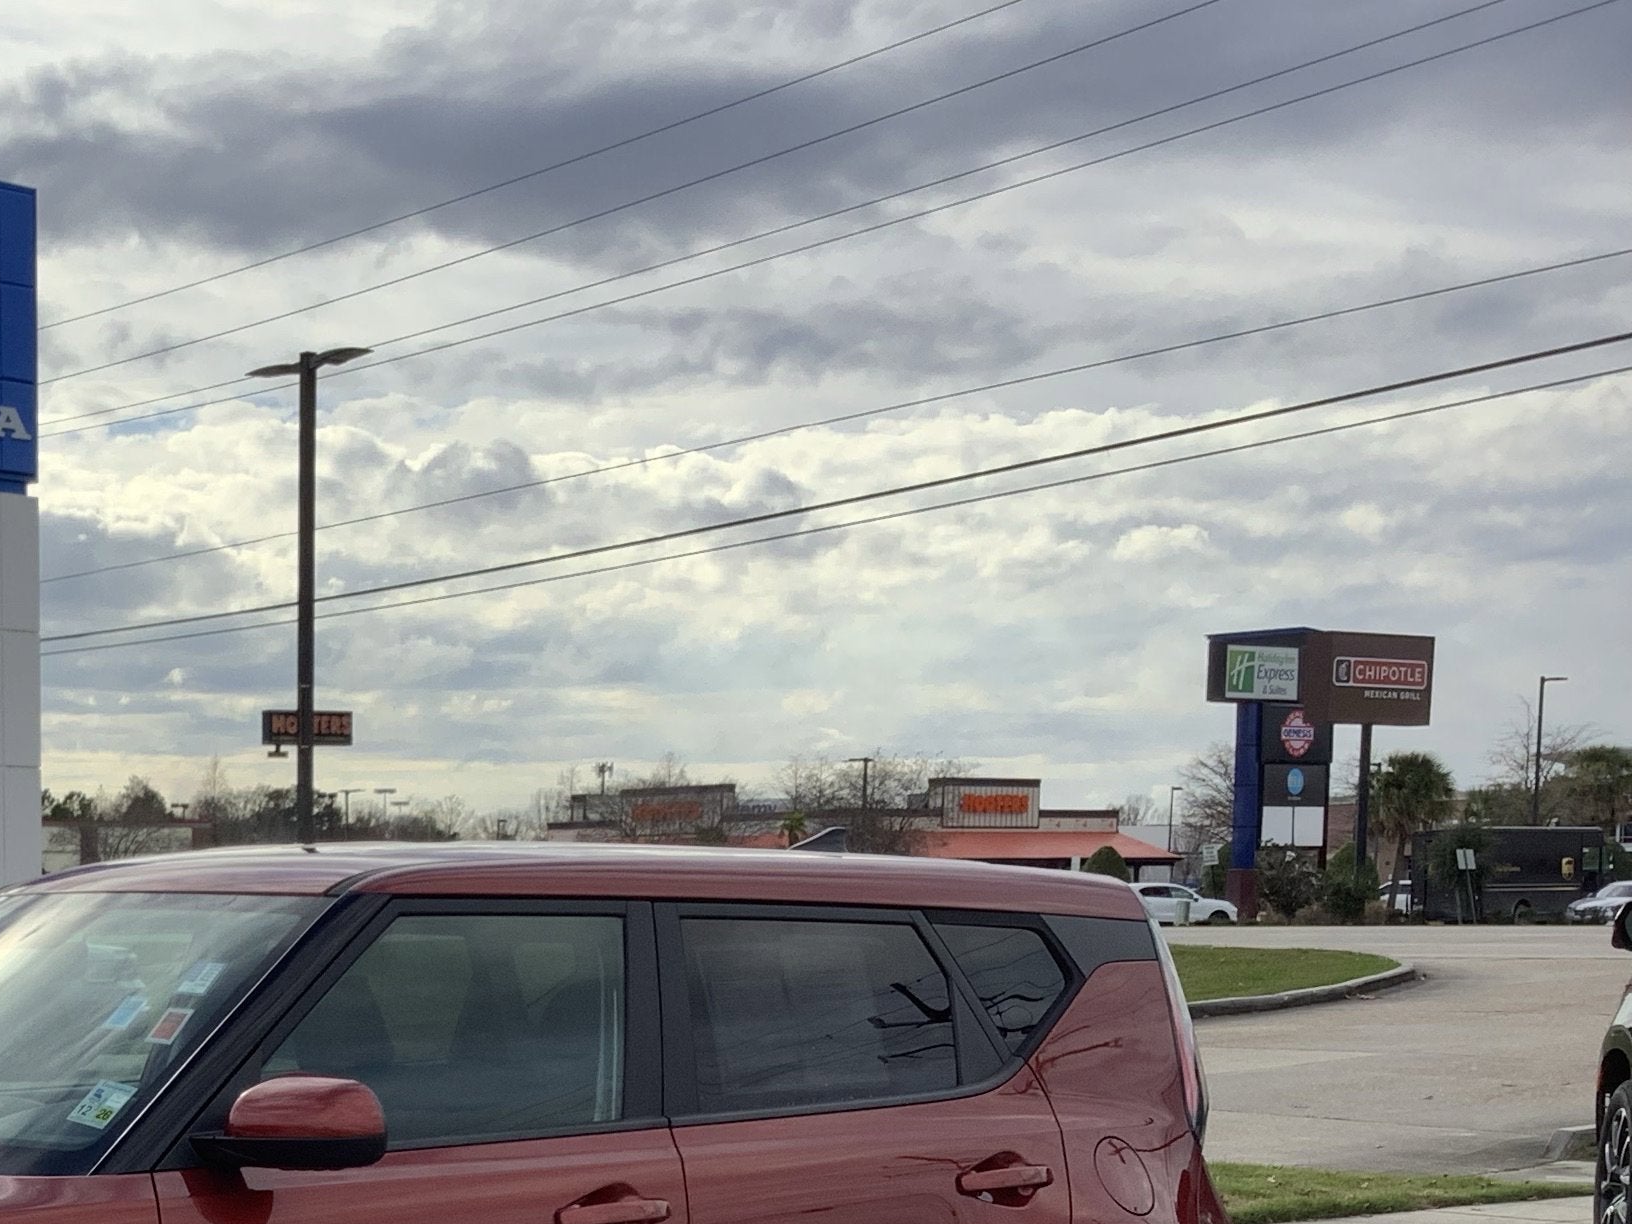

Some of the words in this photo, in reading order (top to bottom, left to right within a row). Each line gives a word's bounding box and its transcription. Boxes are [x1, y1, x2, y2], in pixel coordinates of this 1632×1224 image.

[1257, 664, 1295, 683] Express
[1355, 665, 1423, 682] CHIPOTLE
[1364, 690, 1398, 699] MEXICAN
[1399, 691, 1421, 701] GRILL
[271, 714, 351, 735] HOTERS
